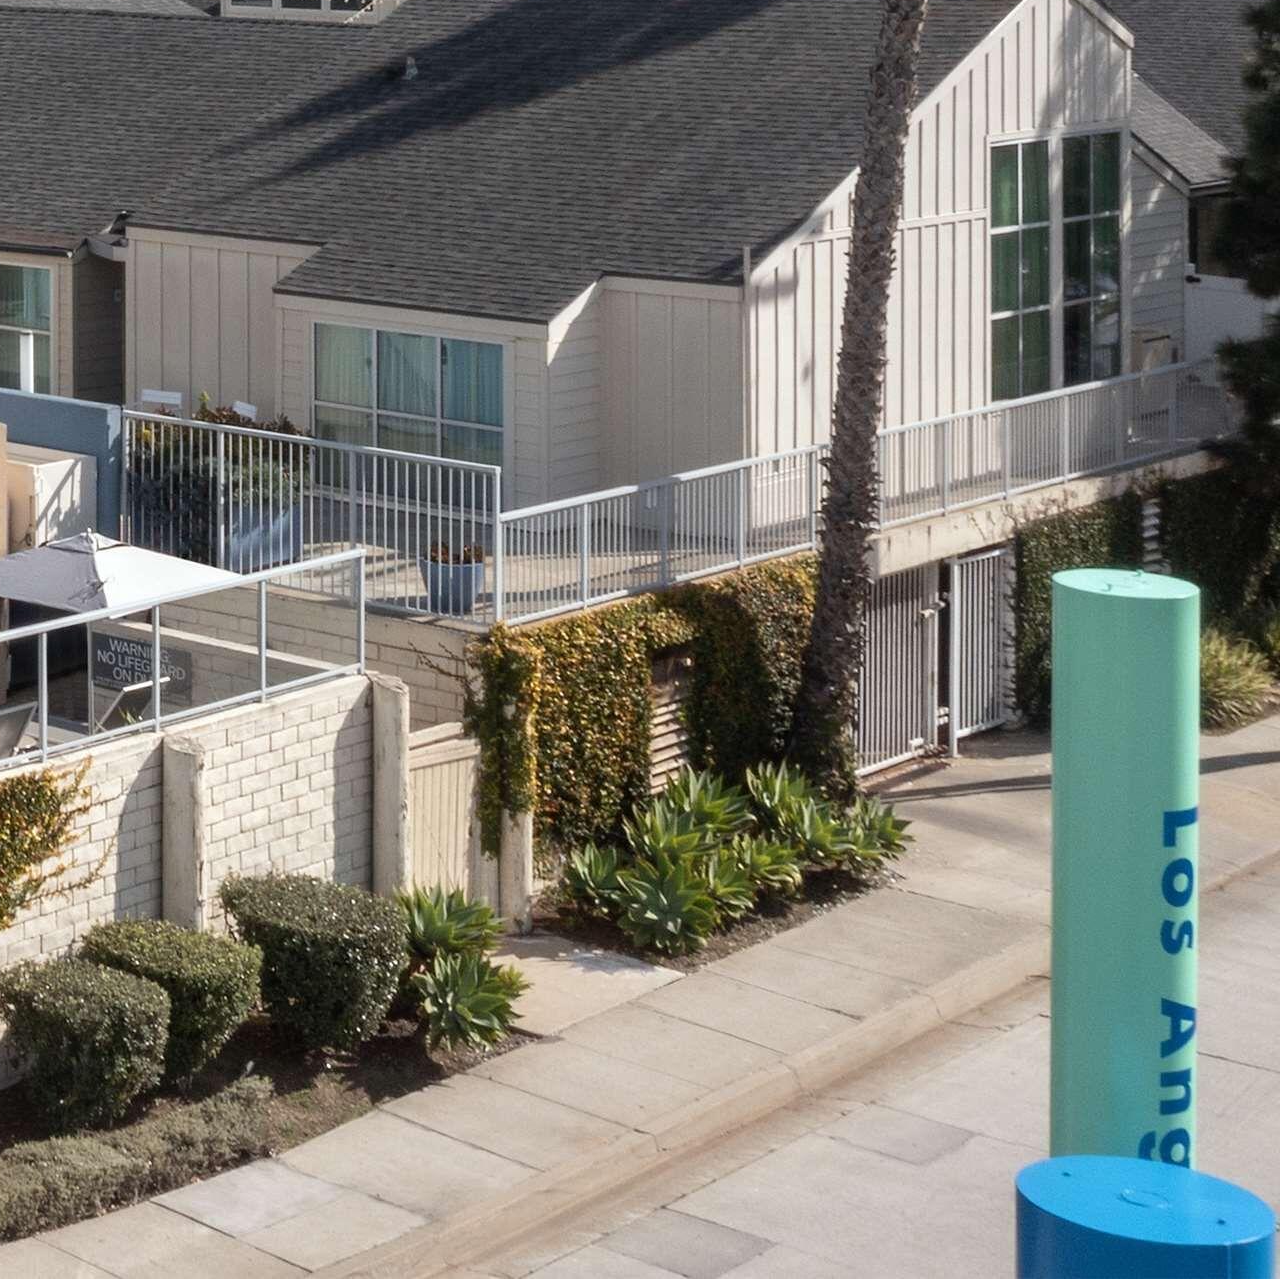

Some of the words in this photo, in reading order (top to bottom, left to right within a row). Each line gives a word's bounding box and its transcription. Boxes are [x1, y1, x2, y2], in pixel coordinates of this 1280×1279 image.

[97, 649, 116, 665] NO
[118, 654, 185, 680] LIFEGARD
[113, 667, 132, 682] ON
[1160, 807, 1198, 955] Los
